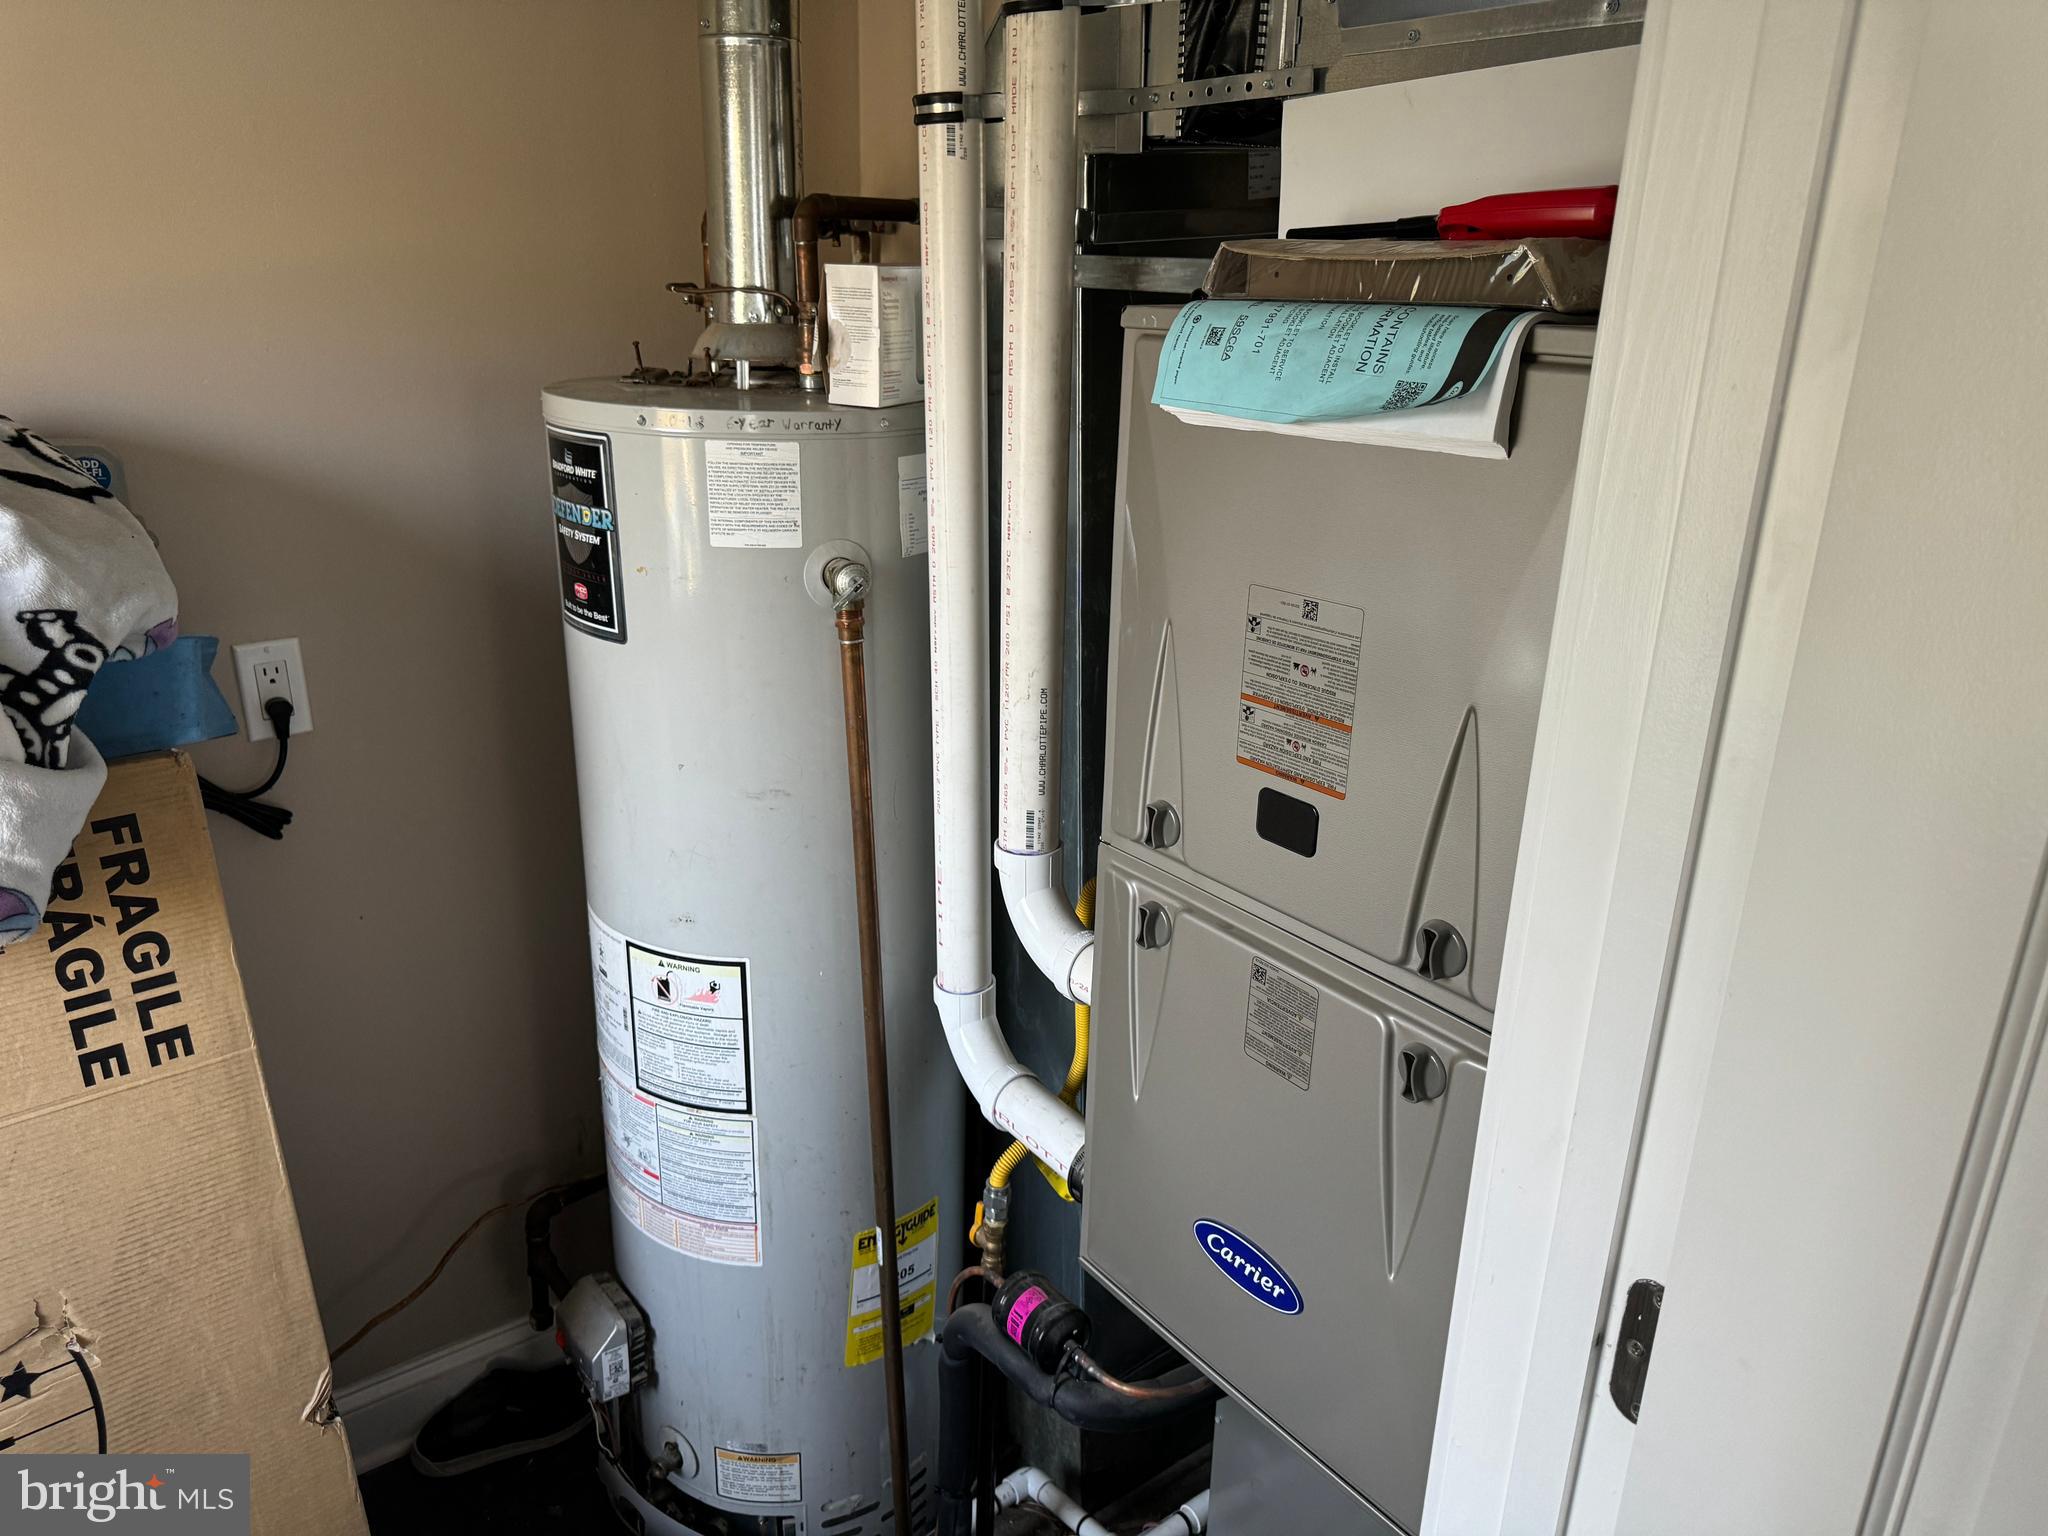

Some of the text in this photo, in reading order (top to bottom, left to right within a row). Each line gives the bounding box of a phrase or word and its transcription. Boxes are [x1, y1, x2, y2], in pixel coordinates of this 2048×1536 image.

[1011, 46, 1018, 65] IN
[1221, 314, 1249, 362] 59SC6A
[1337, 343, 1346, 354] TO
[1269, 338, 1287, 375] ADJACENT
[1274, 349, 1289, 382] SERVICE
[1318, 344, 1337, 384] ADJACENT
[1325, 355, 1341, 385] INSTALL
[575, 465, 597, 479] WHITE
[558, 523, 601, 546] SAFETY SYSTEM
[1038, 687, 1048, 796] WWW.CHARLOTTEPIPE.COM
[90, 812, 196, 1068] FRAGILE
[42, 847, 131, 1088] RÁGILE
[666, 962, 700, 974] WARNING
[1207, 1233, 1285, 1298] Carrier
